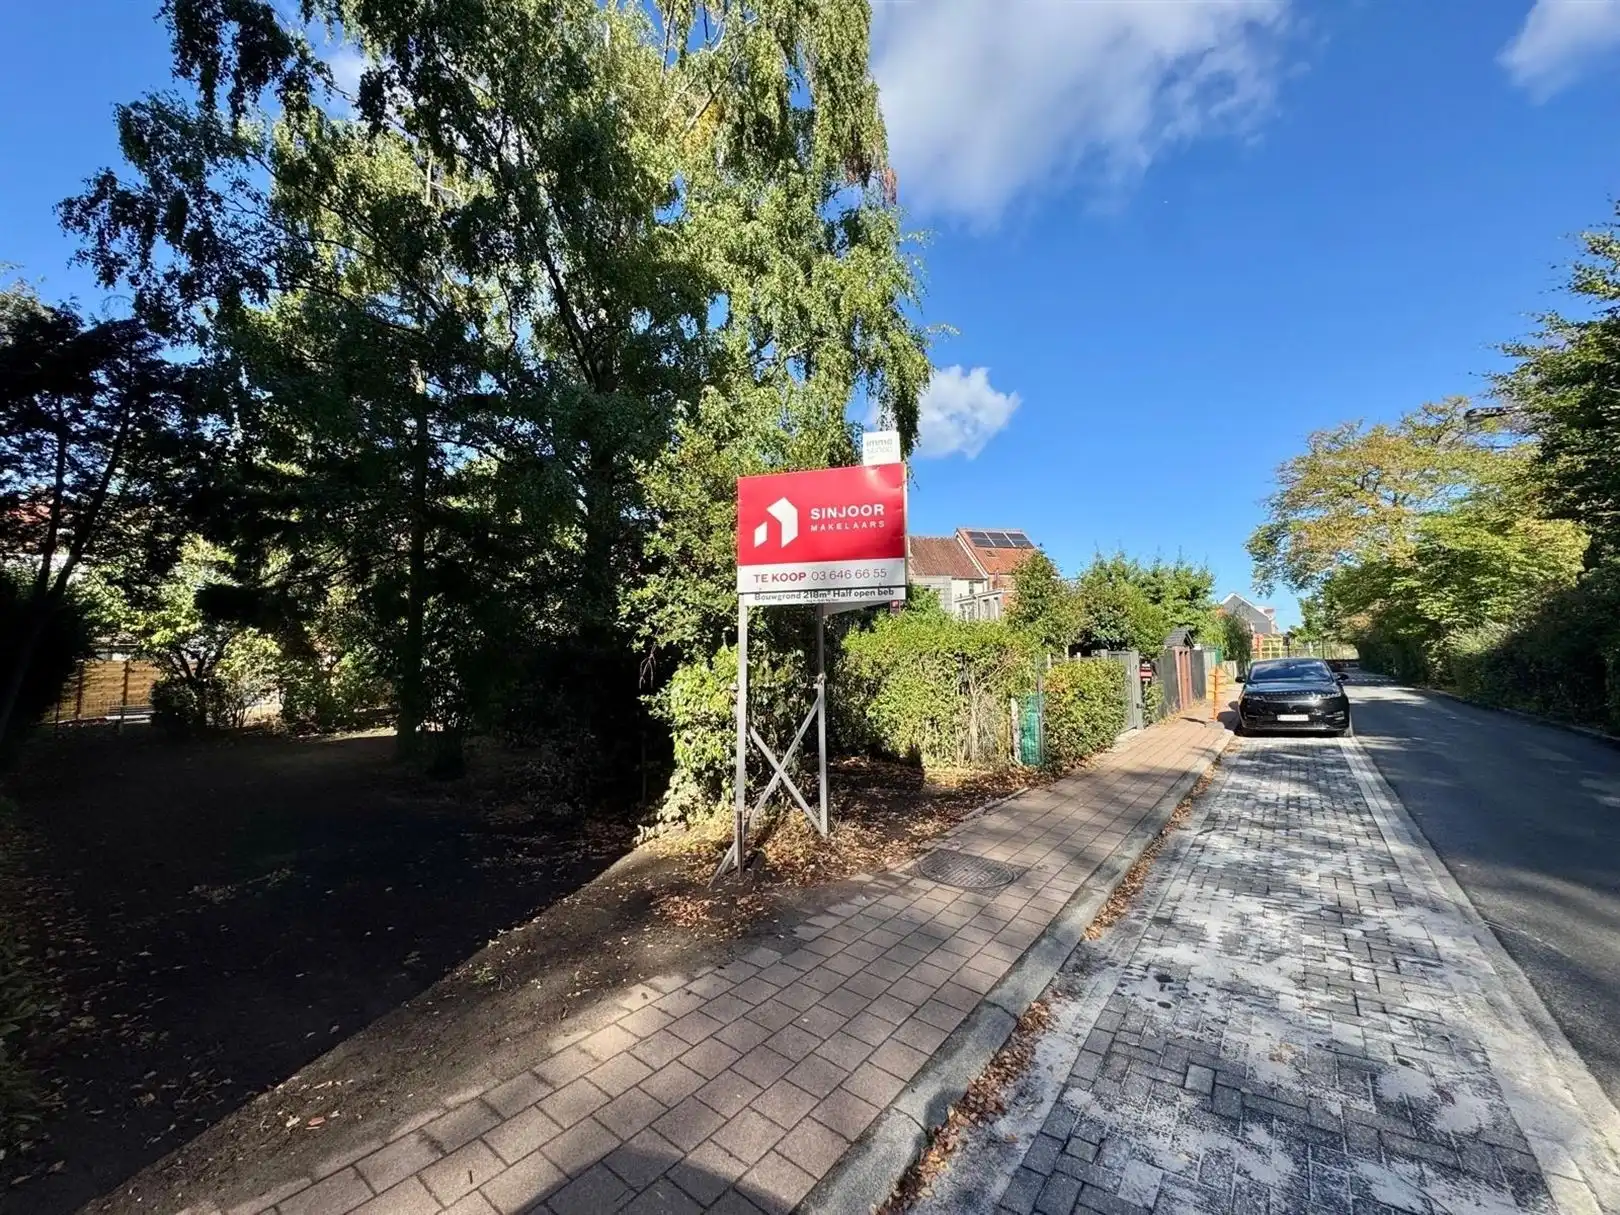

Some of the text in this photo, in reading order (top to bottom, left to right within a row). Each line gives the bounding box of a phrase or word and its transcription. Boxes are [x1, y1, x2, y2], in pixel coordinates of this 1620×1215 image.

[810, 504, 885, 520] SINJOOR
[810, 520, 885, 532] MAKELAARS
[753, 568, 887, 583] TE KOOP 03 646 66 55
[754, 592, 801, 601] Bouwgrond
[833, 588, 852, 598] Half
[854, 590, 876, 598] open
[877, 587, 895, 596] beb
